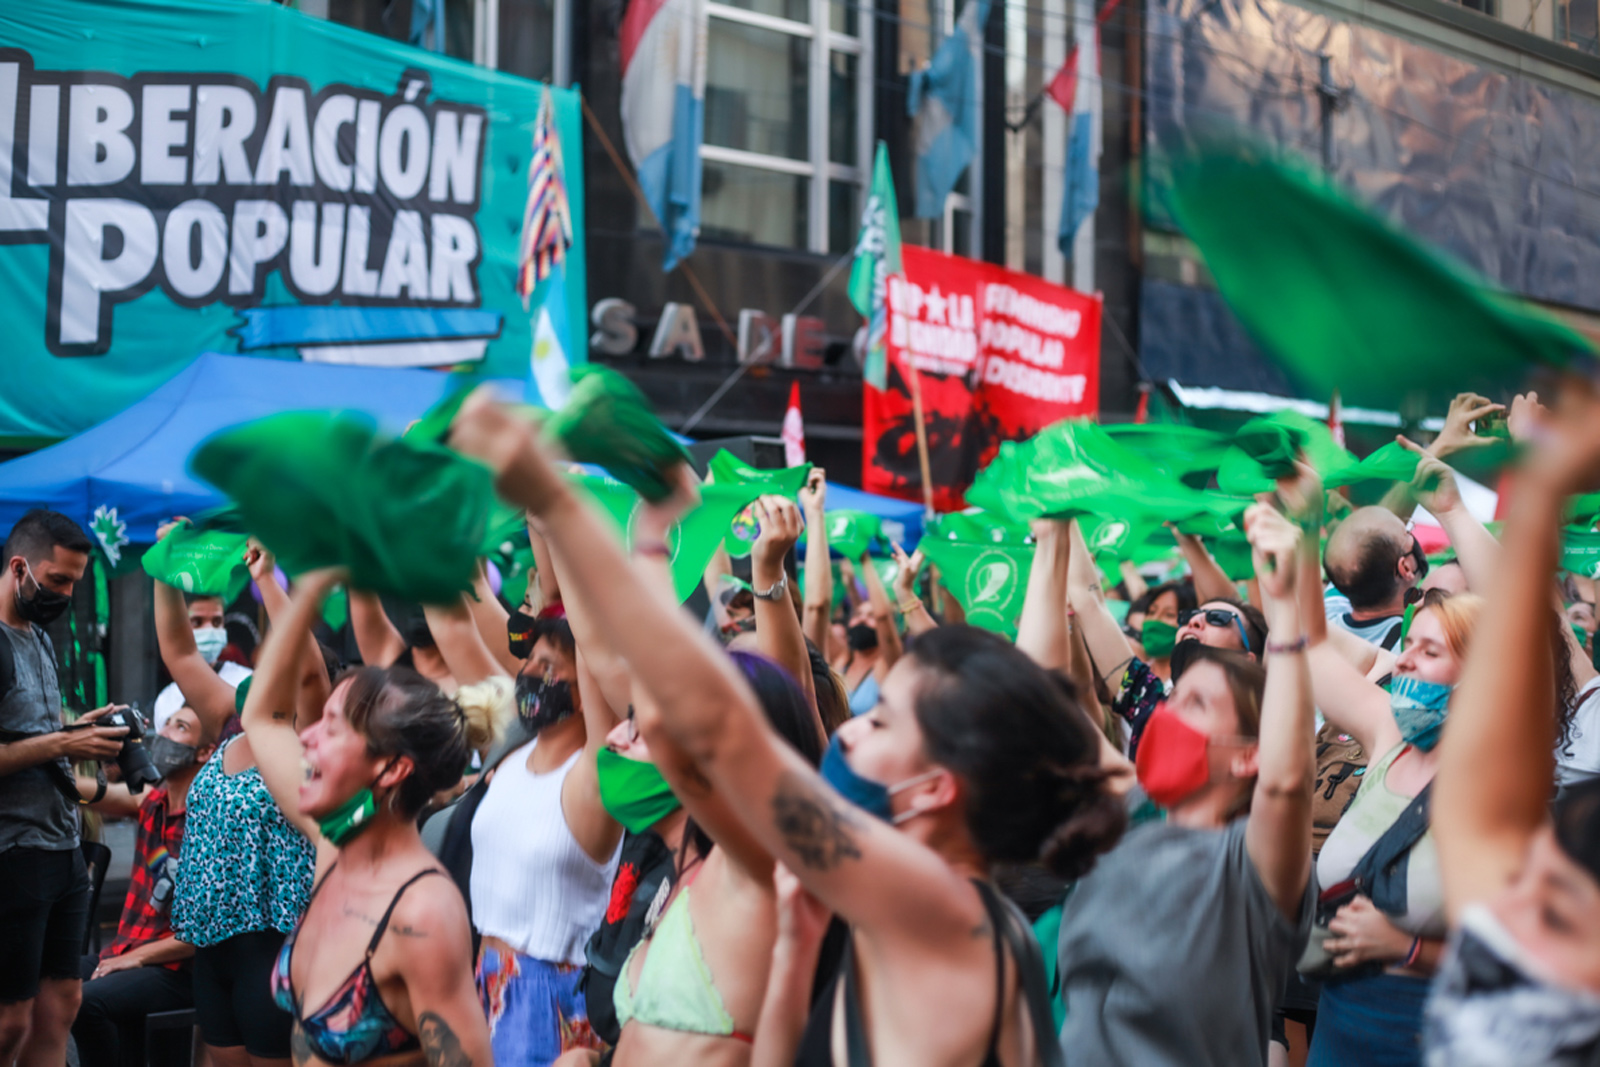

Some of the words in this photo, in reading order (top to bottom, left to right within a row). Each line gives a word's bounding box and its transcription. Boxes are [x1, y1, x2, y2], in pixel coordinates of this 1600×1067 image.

[0, 62, 484, 230] LIBERACIÓN
[58, 198, 481, 345] POPULAR
[736, 308, 826, 370] DE
